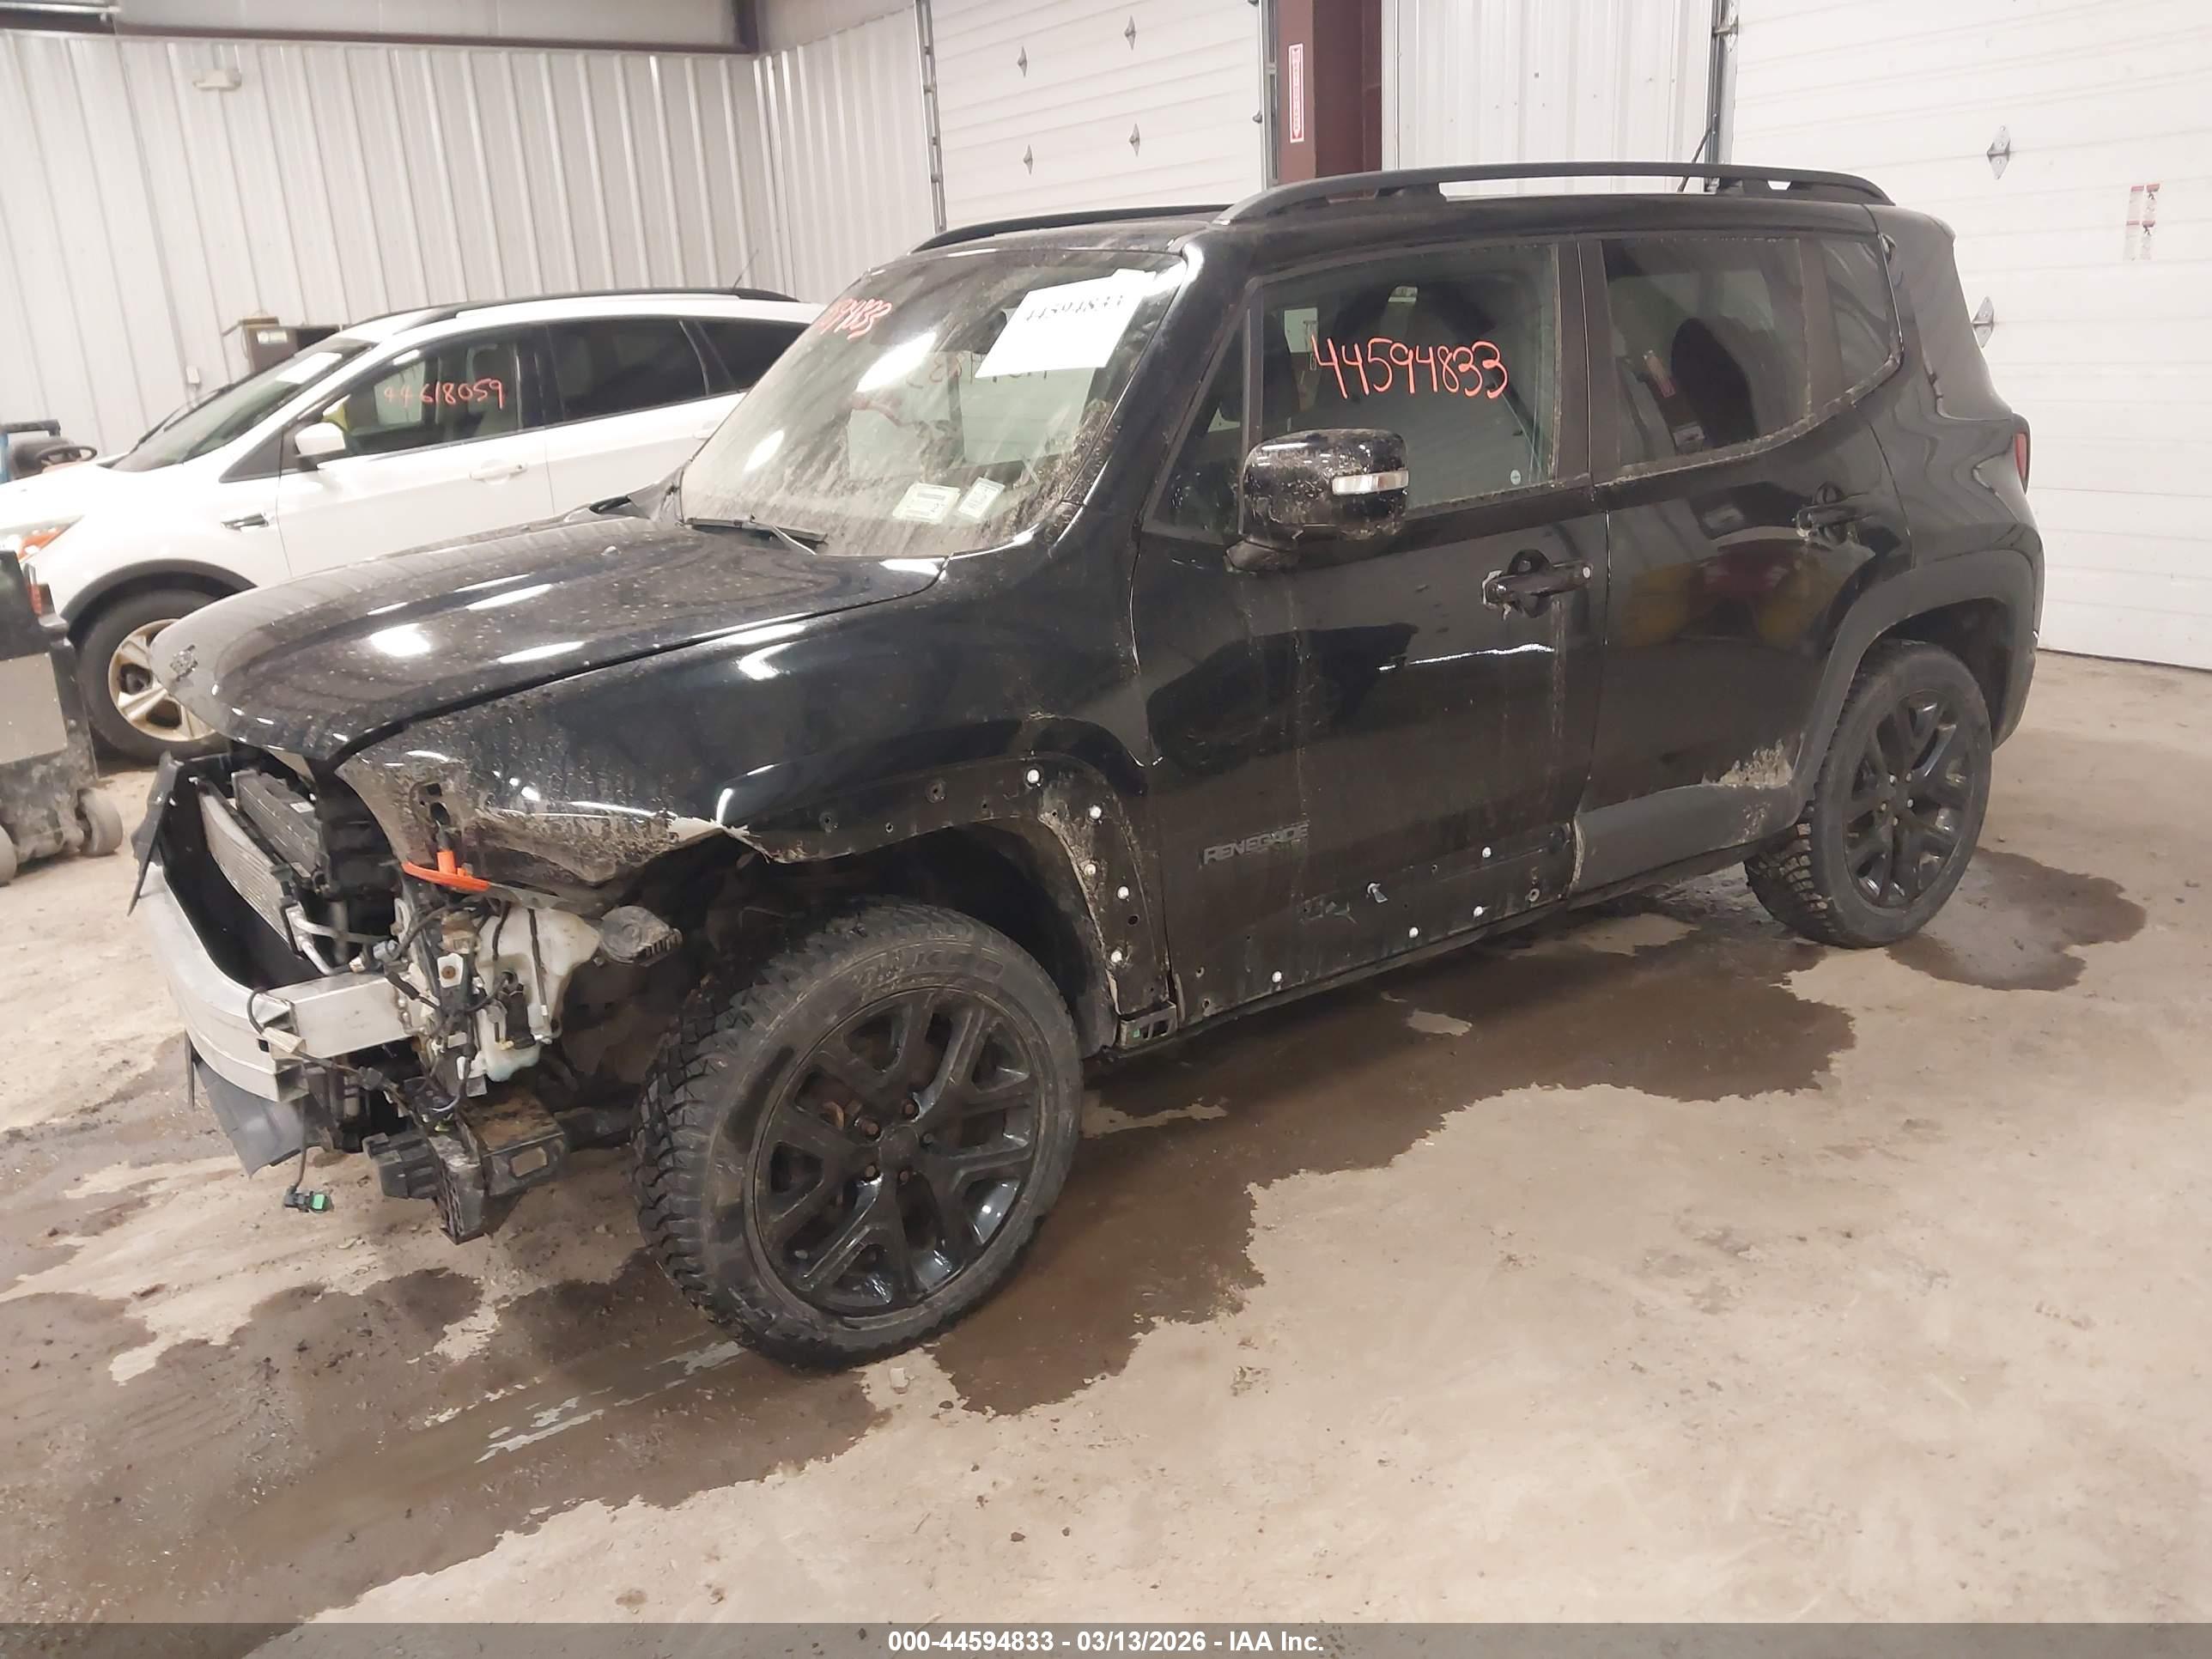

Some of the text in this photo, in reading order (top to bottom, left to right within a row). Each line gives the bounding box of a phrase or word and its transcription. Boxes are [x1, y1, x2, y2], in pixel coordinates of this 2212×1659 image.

[1310, 333, 1509, 399] 44594833
[383, 377, 504, 410] 44618059
[1204, 821, 1310, 865] RENEGADE
